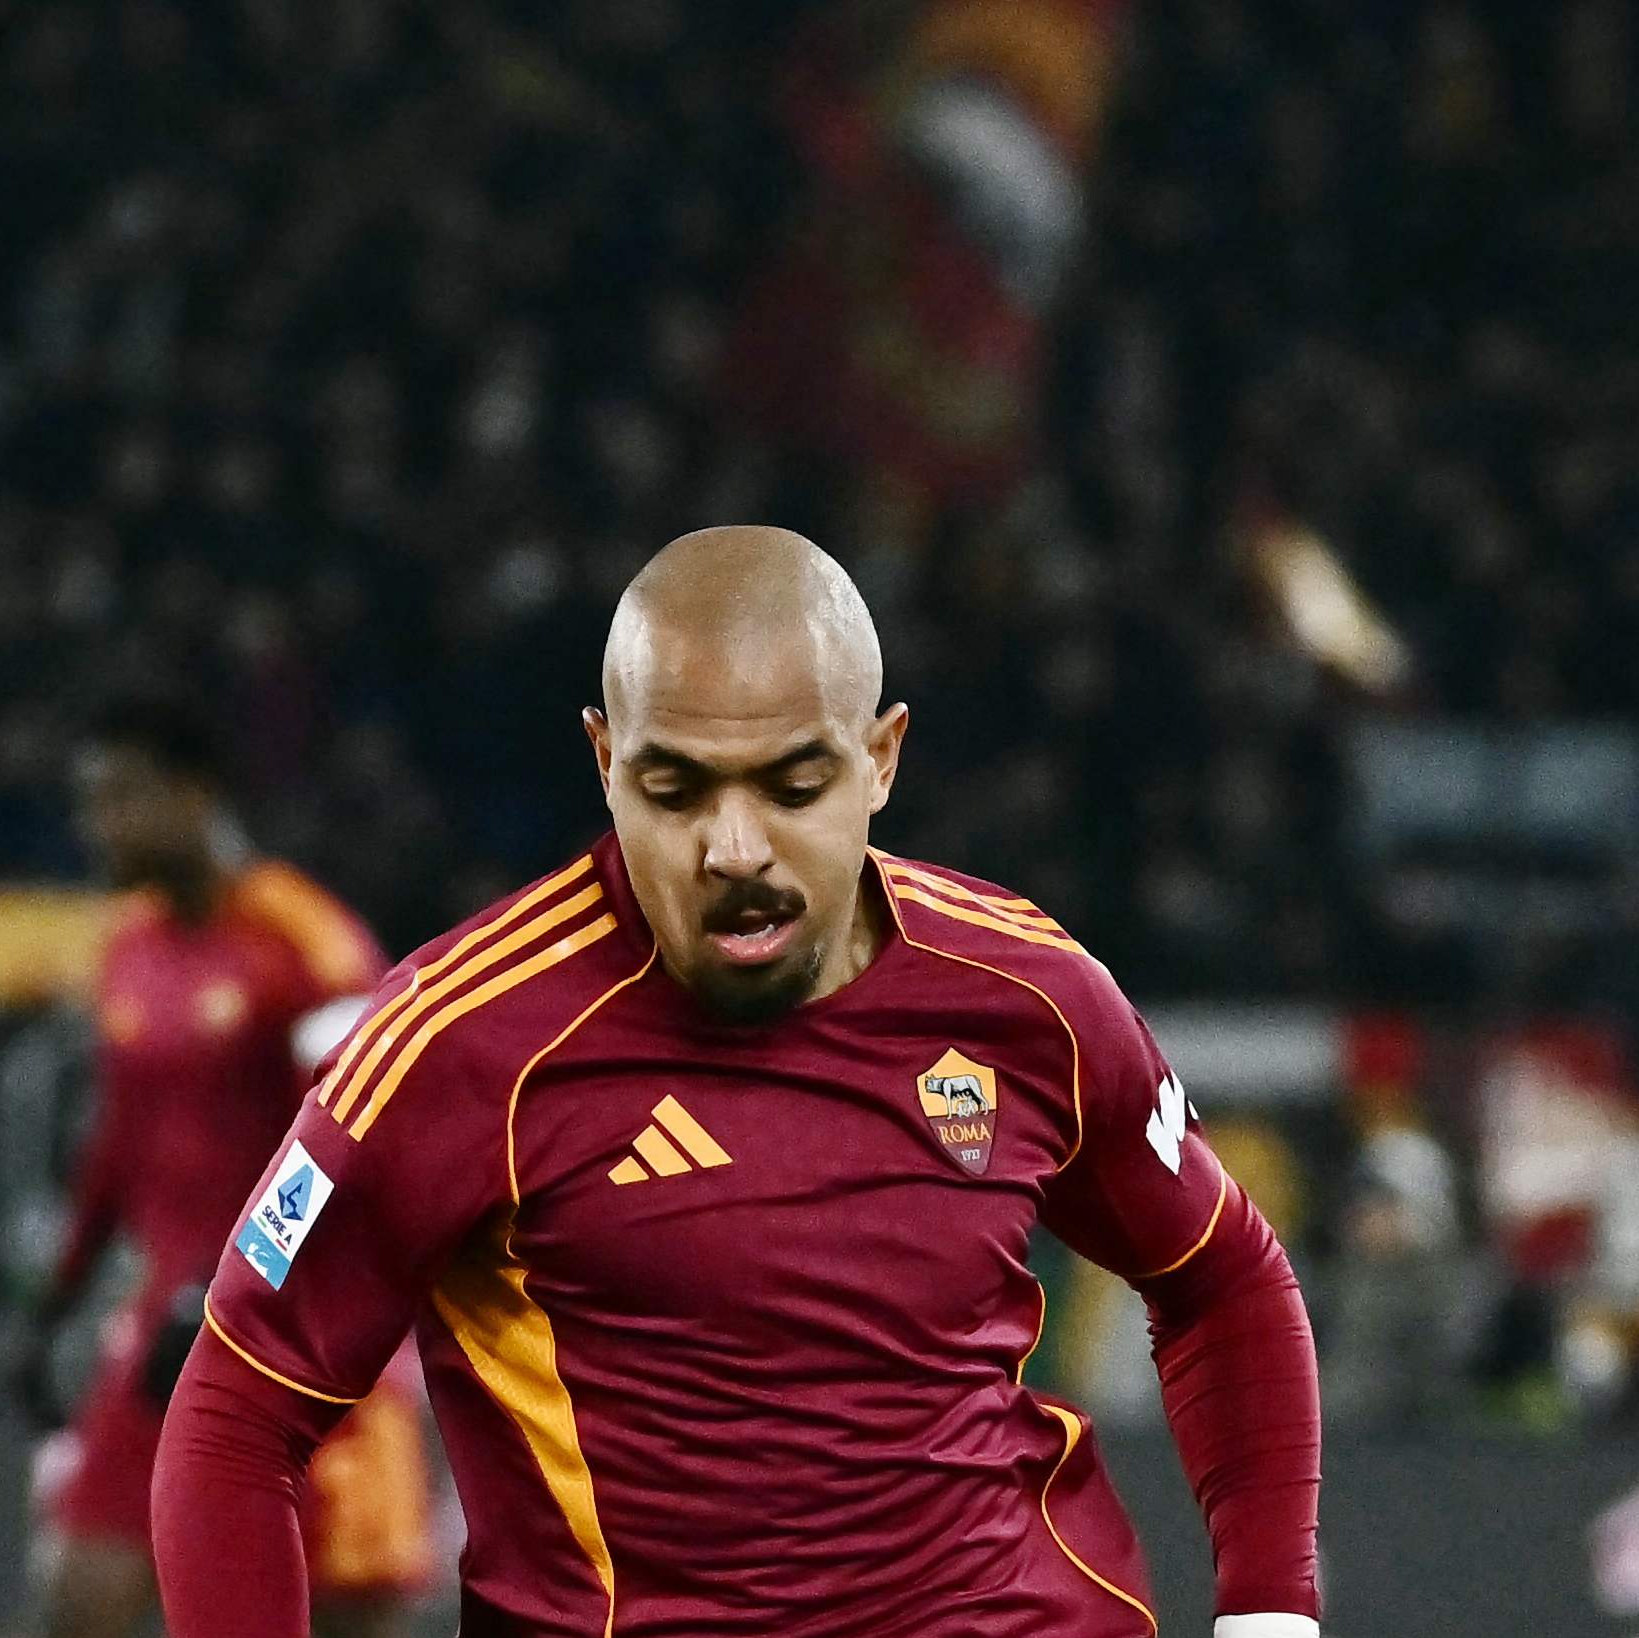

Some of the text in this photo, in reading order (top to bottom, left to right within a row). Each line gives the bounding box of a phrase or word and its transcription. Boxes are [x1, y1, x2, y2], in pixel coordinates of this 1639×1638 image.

[938, 1122, 993, 1144] ROMA
[261, 1204, 293, 1246] SERIE A
